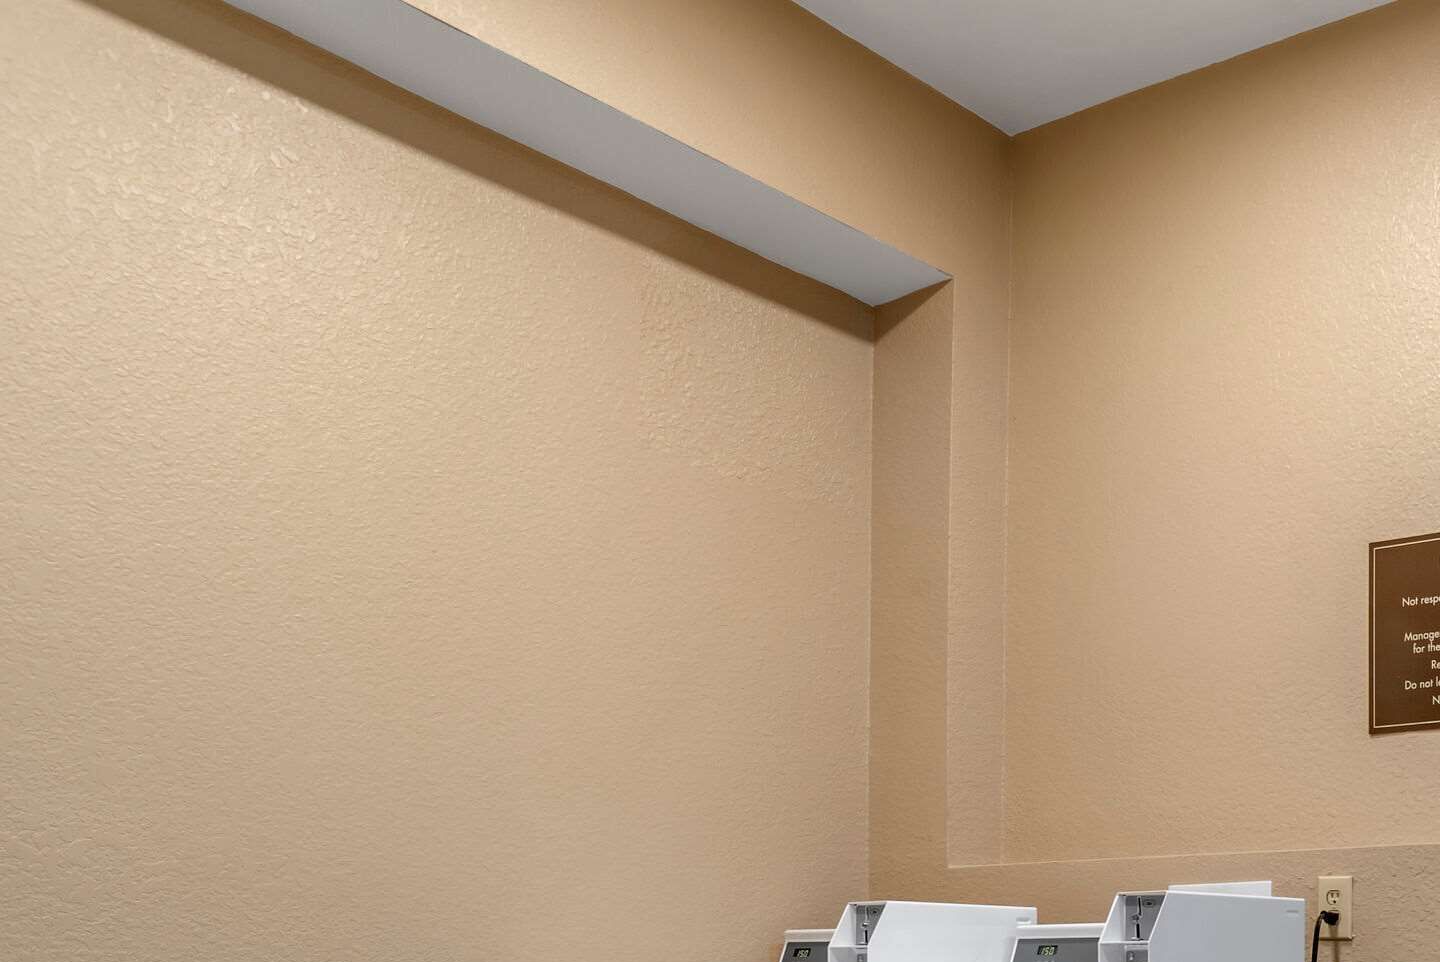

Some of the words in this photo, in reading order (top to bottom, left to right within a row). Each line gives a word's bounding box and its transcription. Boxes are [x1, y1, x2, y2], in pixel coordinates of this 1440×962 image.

[1402, 596, 1418, 607] Not
[1412, 643, 1424, 654] for
[1427, 640, 1440, 651] the
[1404, 680, 1416, 689] Do
[1419, 679, 1433, 688] not
